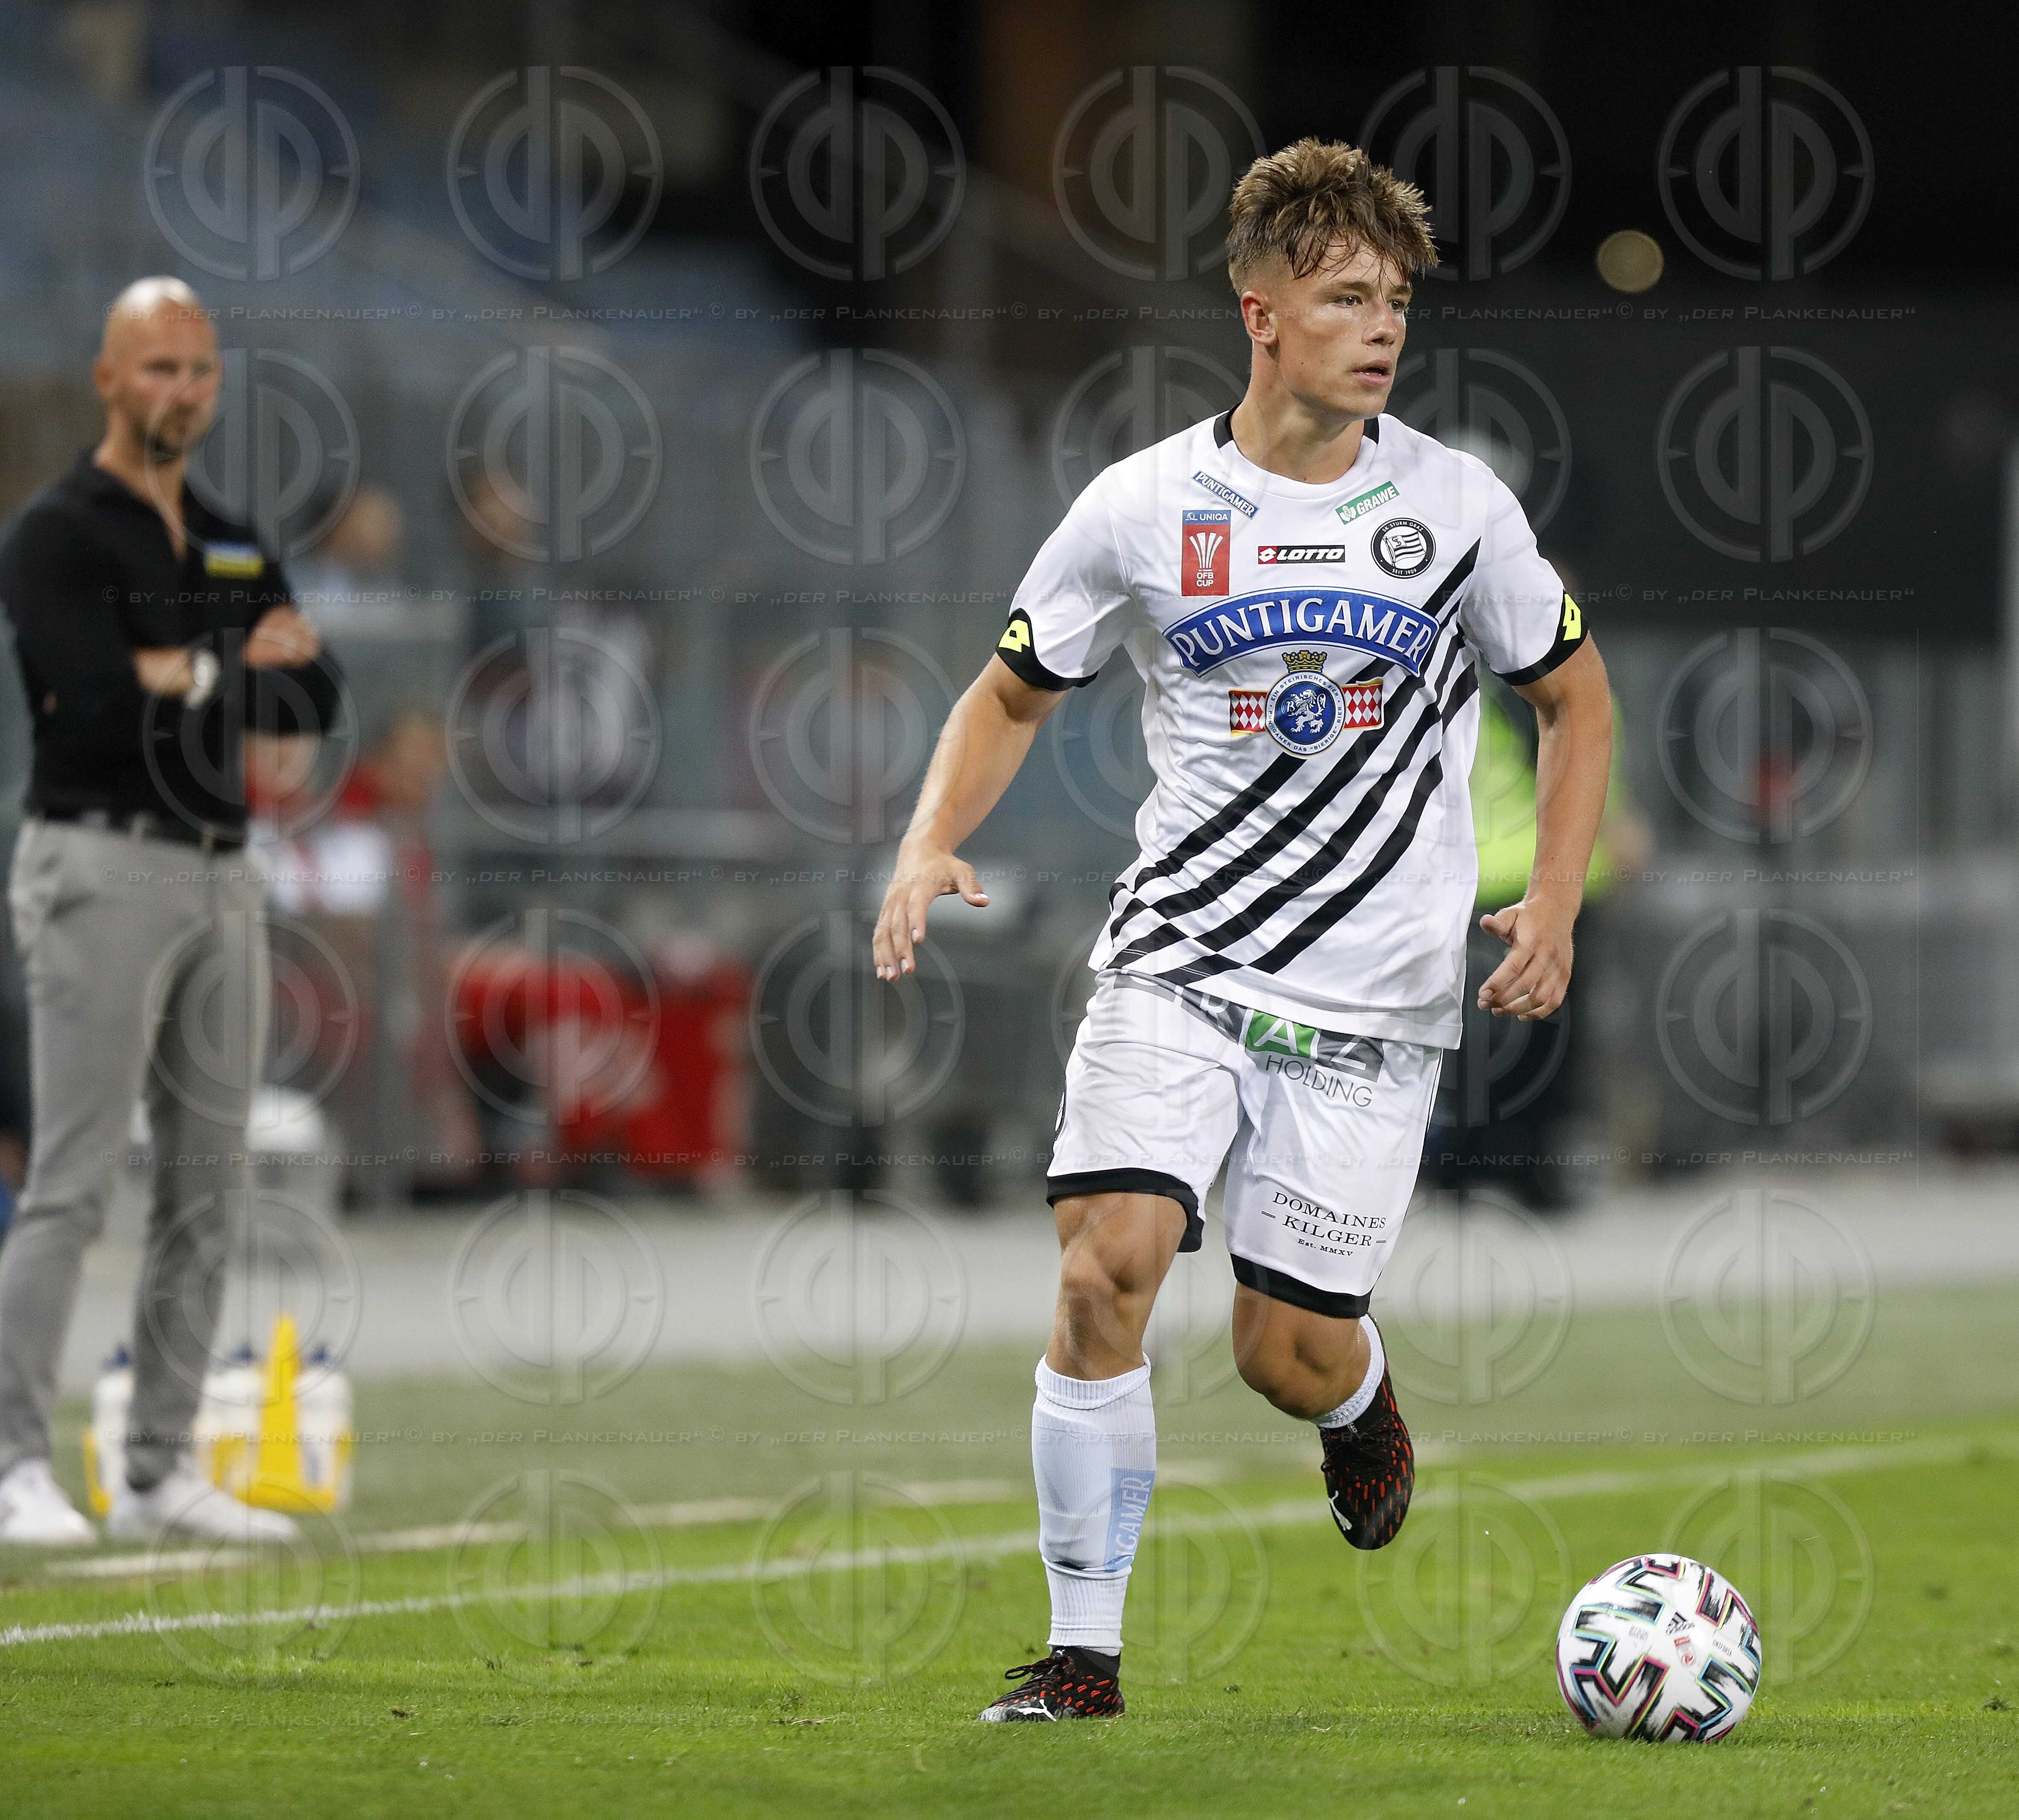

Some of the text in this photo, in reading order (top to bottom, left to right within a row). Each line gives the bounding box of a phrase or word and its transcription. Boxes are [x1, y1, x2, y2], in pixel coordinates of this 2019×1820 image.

[1196, 471, 1255, 516] PUNTIGAMER
[1357, 486, 1397, 515] GRAWE
[1409, 522, 1423, 531] GRAZ
[1277, 548, 1344, 560] LOTTO
[1171, 598, 1432, 666] PUNTIGAMER
[1280, 675, 1327, 689] STEIRISCHES
[1265, 1055, 1372, 1108] HOLDING
[1272, 1191, 1386, 1228] DOMAINES
[1282, 1215, 1372, 1247] KILGER
[1298, 1238, 1354, 1257] Est. MMXV
